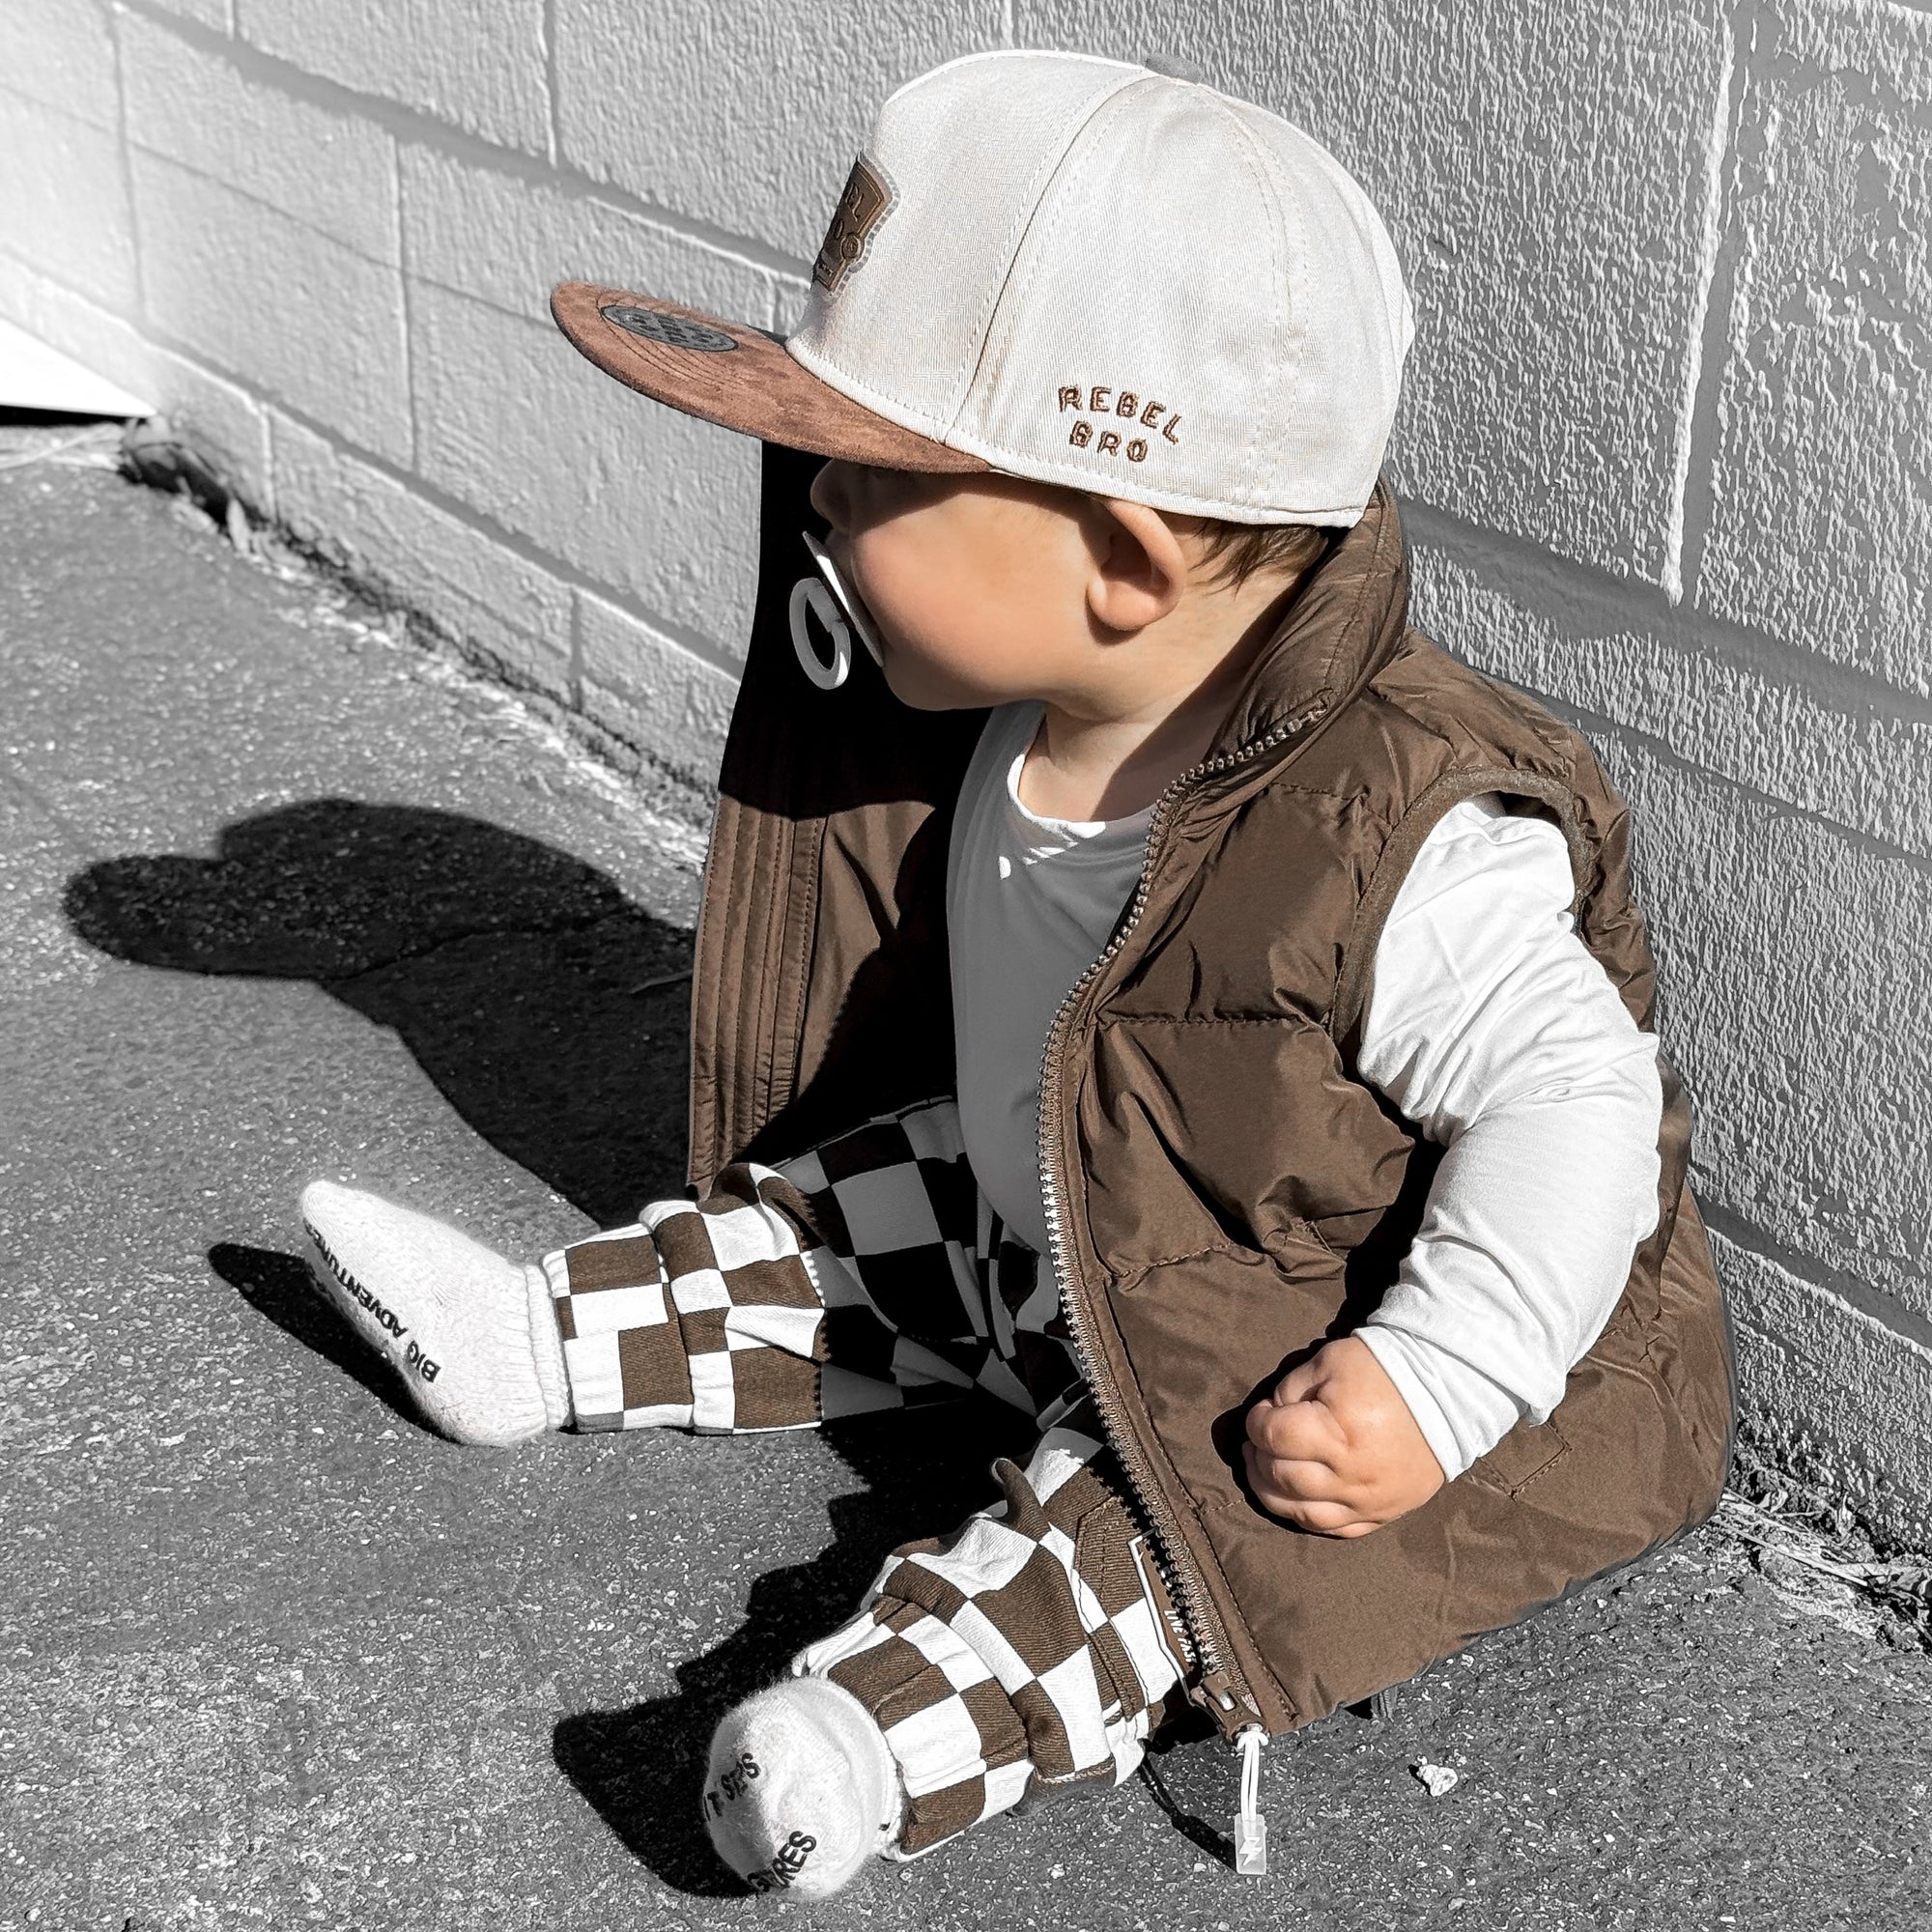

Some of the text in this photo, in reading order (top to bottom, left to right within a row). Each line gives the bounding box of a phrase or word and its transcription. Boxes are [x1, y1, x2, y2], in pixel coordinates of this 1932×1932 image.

[1059, 384, 1181, 444] REBEL
[1069, 420, 1148, 462] BRO
[407, 1340, 441, 1382] BIG
[1164, 1609, 1189, 1635] LIVE
